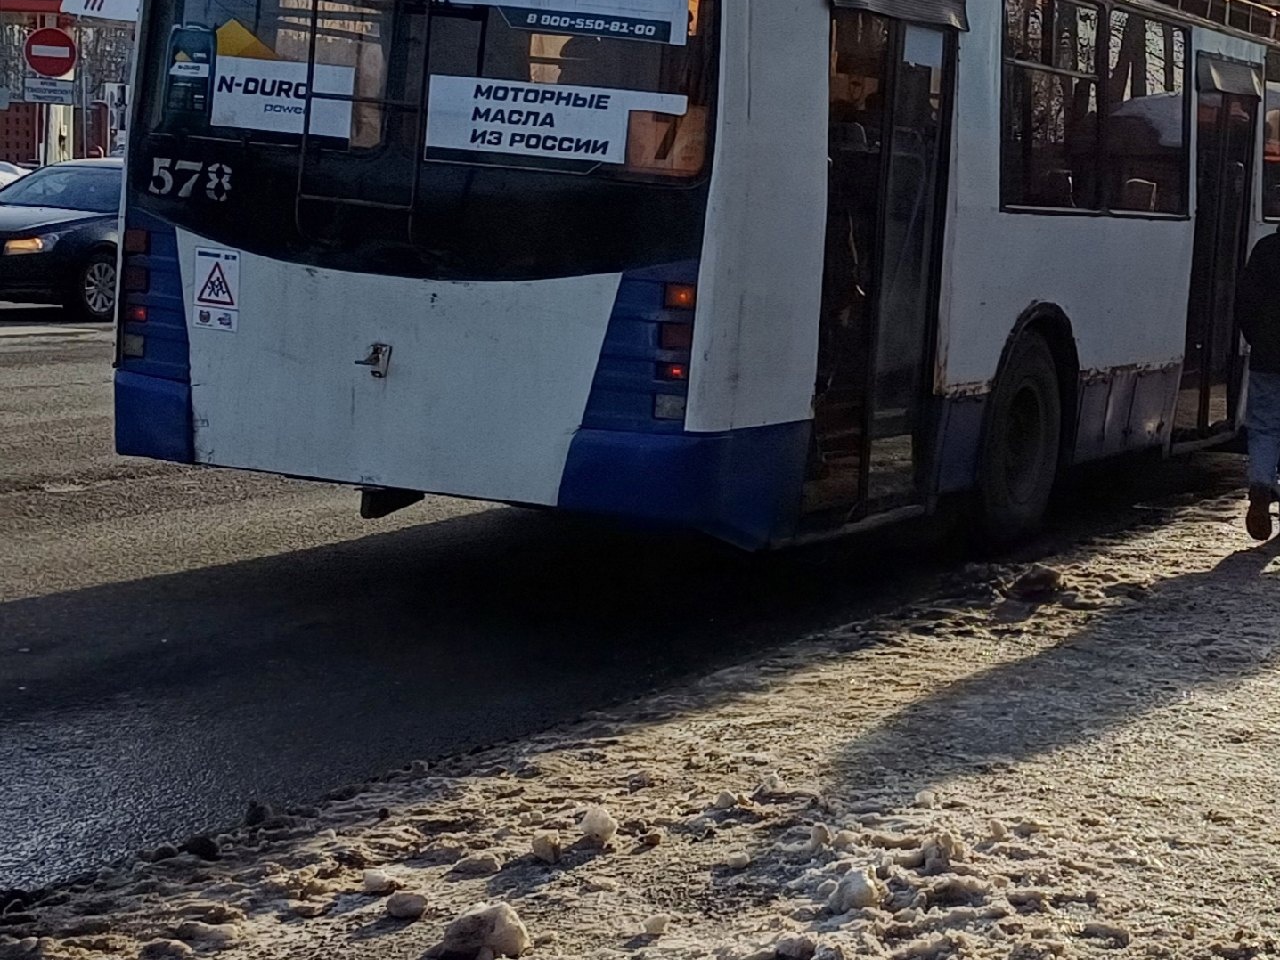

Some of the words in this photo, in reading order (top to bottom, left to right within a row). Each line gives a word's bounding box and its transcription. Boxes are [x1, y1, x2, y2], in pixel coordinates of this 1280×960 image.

[526, 13, 537, 24] 8
[473, 84, 611, 110] МОТОРНЫЕ
[471, 106, 555, 128] МАСЛА
[469, 128, 503, 146] ИЗ
[509, 131, 610, 156] РОССИИ
[148, 157, 233, 202] 578
